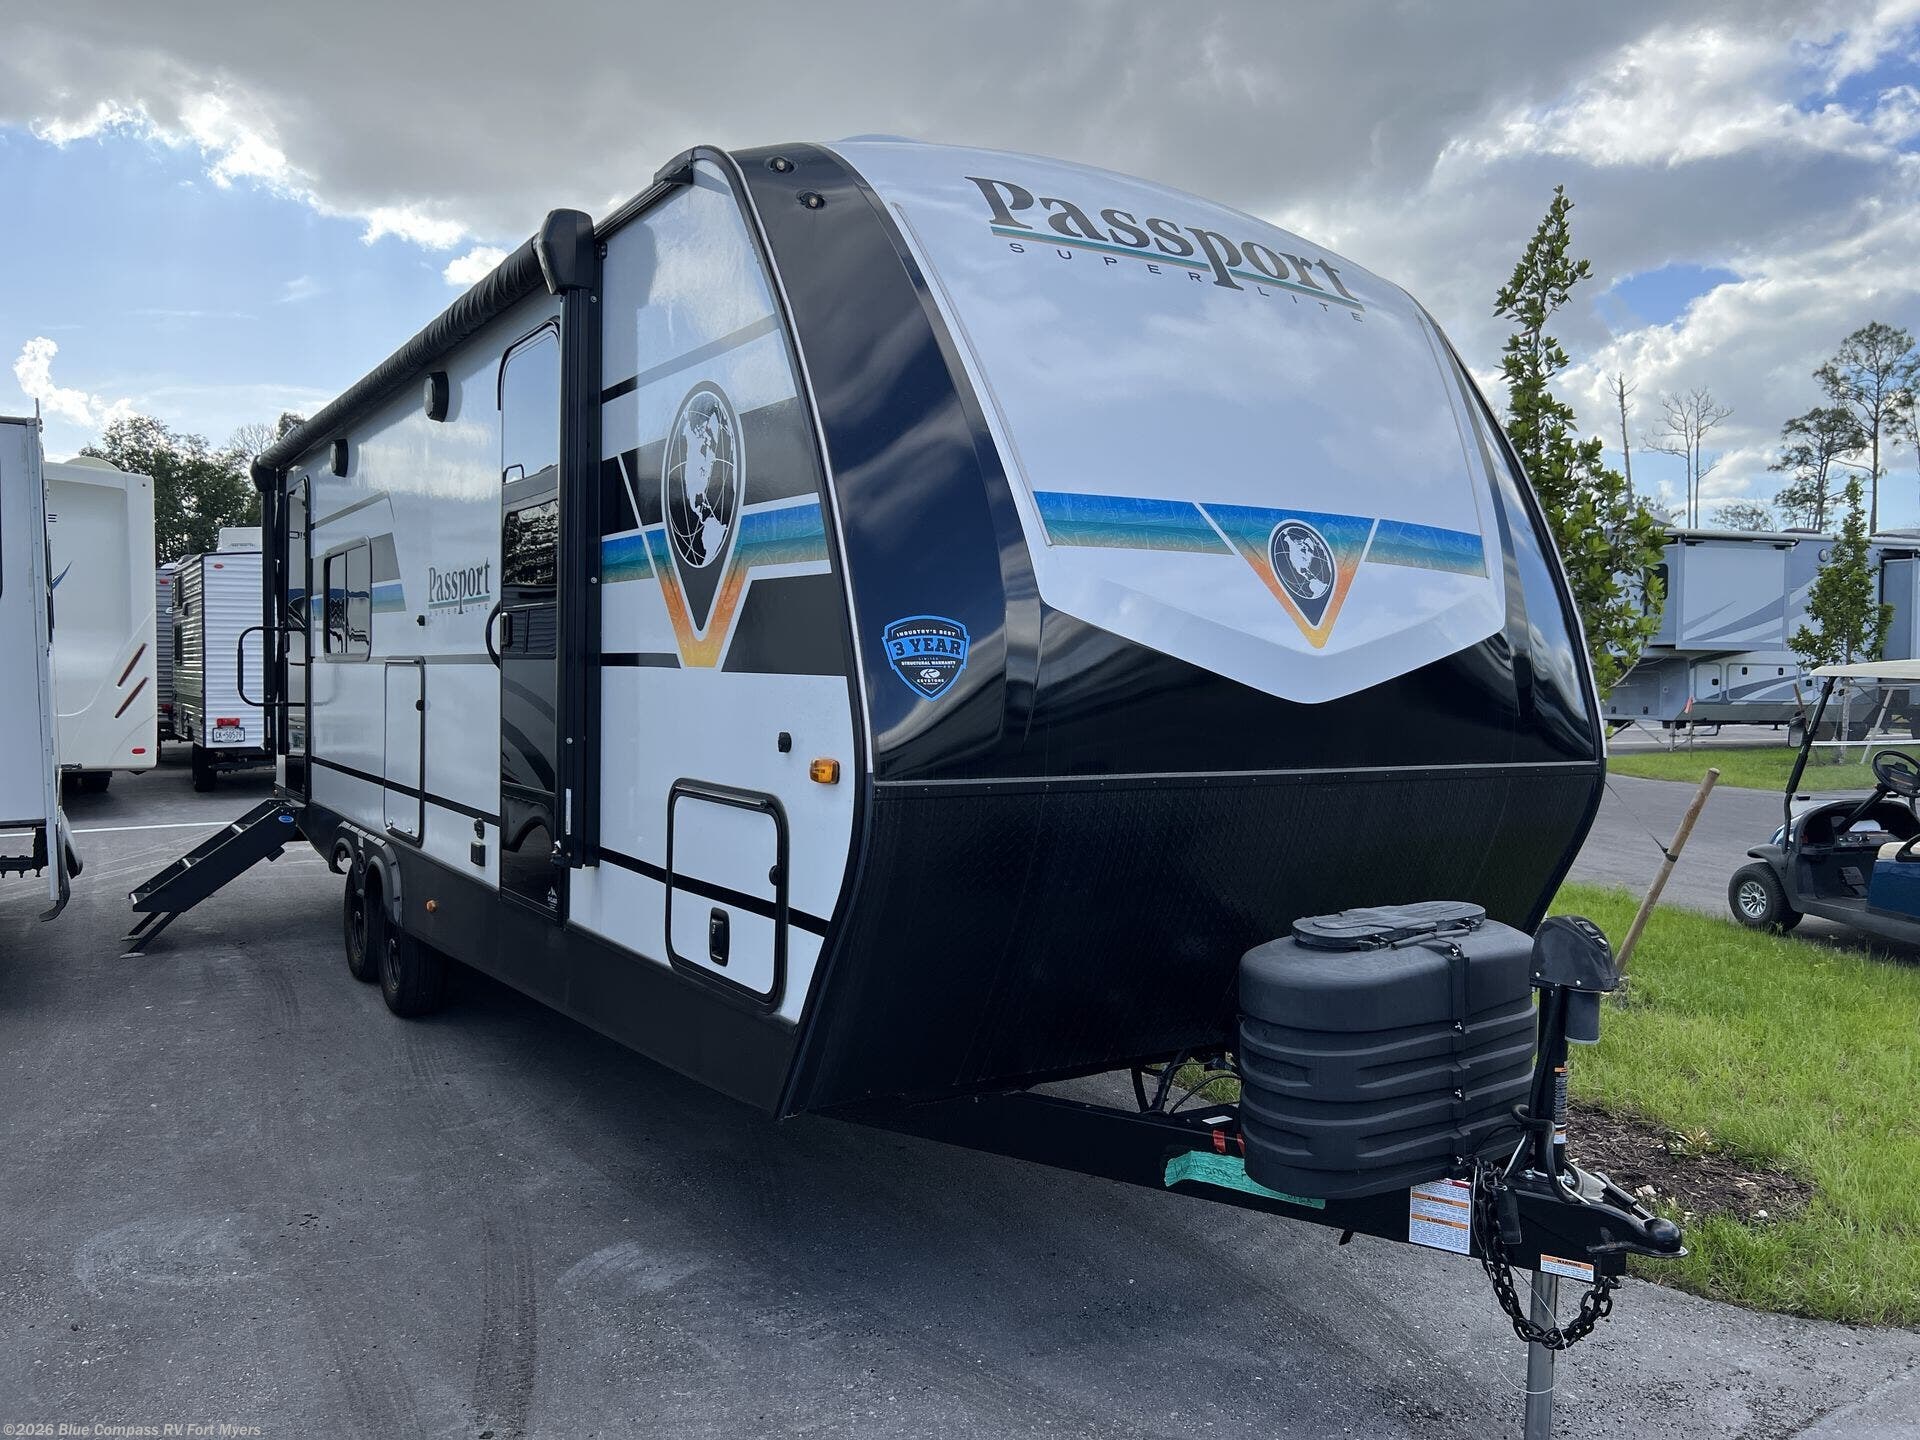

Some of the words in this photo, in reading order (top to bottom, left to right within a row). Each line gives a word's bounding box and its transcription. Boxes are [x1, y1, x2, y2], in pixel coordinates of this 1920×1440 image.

[964, 175, 1360, 303] Passport
[1009, 242, 1203, 283] SUPER
[1256, 286, 1363, 323] LITE
[428, 557, 490, 614] Passport
[893, 641, 905, 656] 3
[909, 637, 961, 655] YEAR
[896, 629, 936, 637] INDUSTRY'S
